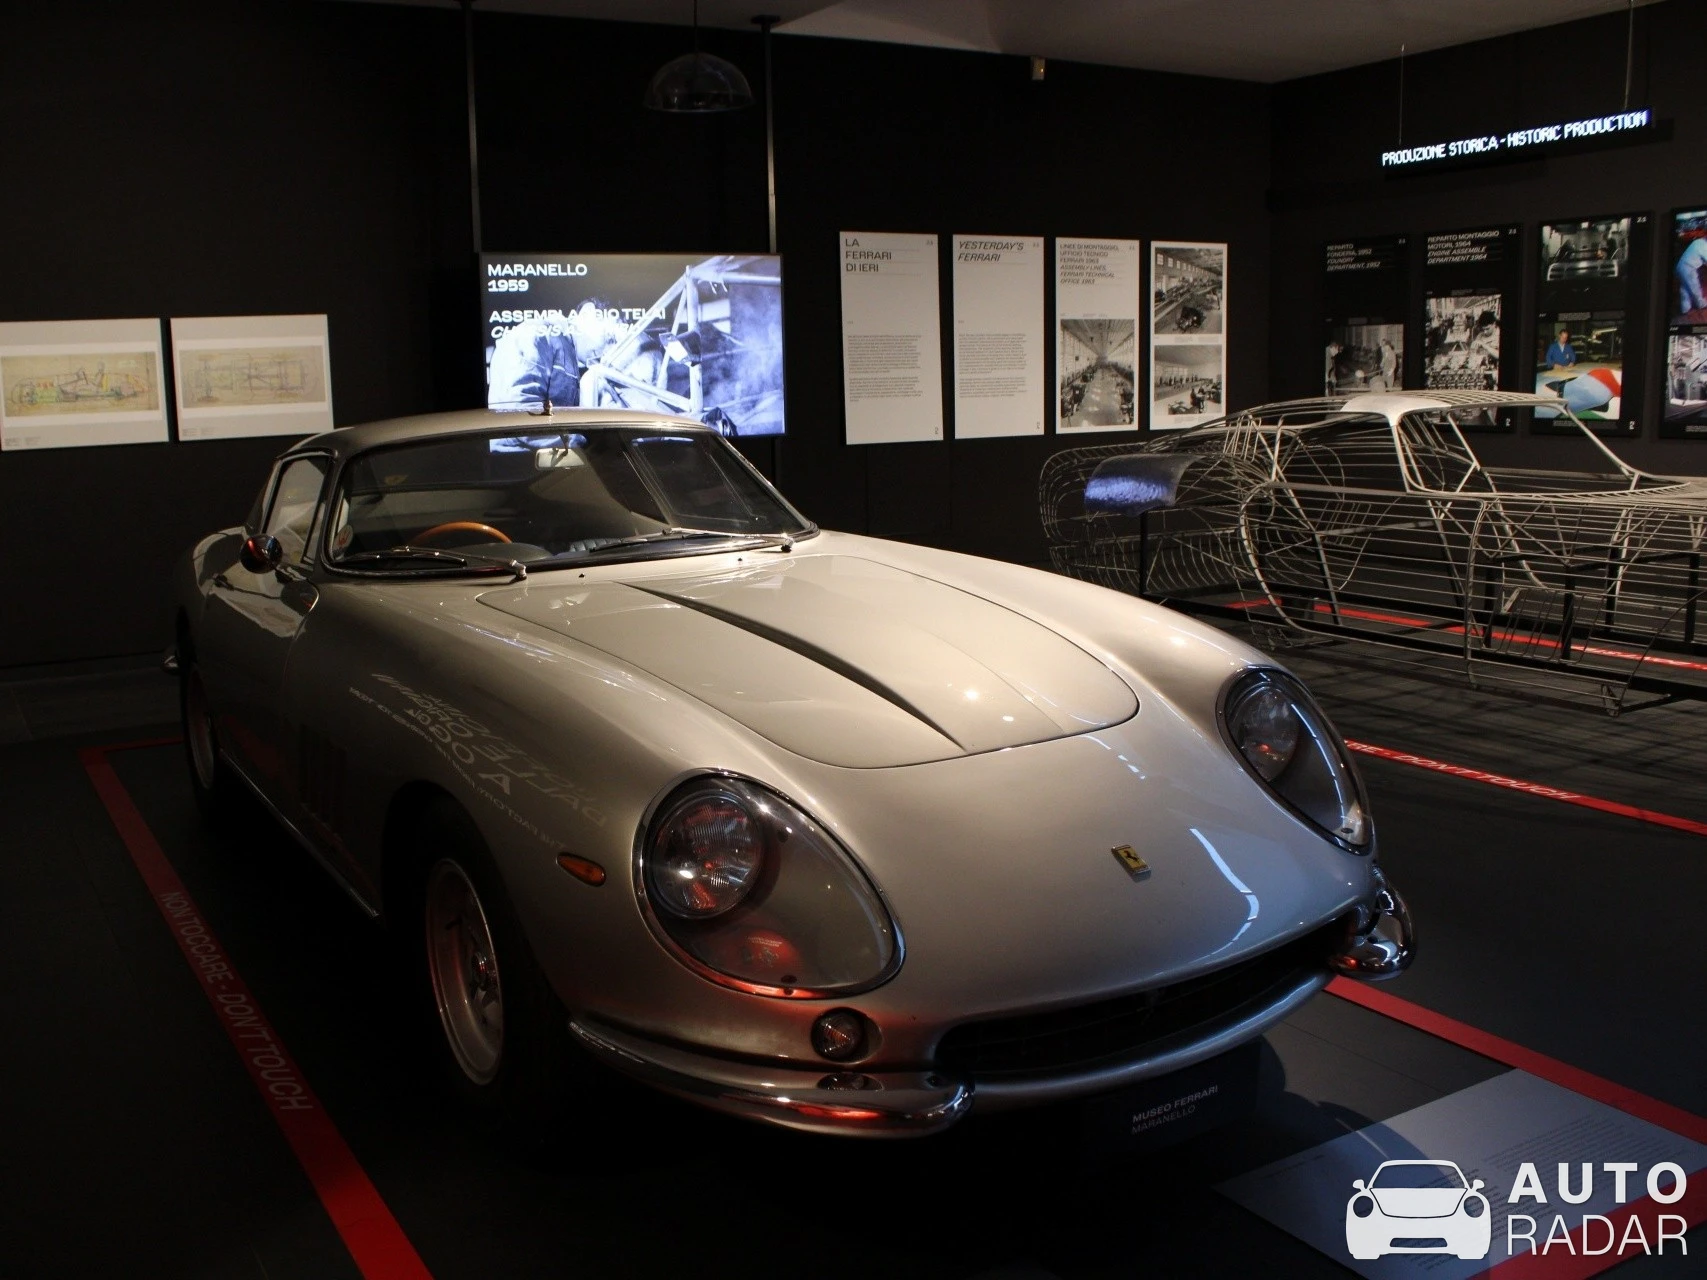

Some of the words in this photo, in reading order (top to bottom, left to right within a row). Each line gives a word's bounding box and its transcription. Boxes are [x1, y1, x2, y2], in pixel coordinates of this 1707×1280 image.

[1382, 143, 1447, 167] PRODUZIONE
[1448, 136, 1498, 157] STORICA
[1507, 125, 1561, 148] HISTORIC
[1564, 110, 1648, 139] PRODUCTION
[845, 238, 859, 247] LA
[958, 240, 1024, 250] YESTERDAY'S
[845, 250, 892, 260] FERRARI
[957, 252, 1001, 262] FERRARI
[488, 263, 587, 276] MARANELLO
[846, 263, 857, 272] DI
[859, 263, 879, 273] IERI
[488, 279, 529, 292] 1959
[1475, 773, 1583, 799] TOUCH
[161, 891, 192, 918] NON
[177, 916, 234, 984] TOCCARE
[217, 992, 273, 1042] DON'T
[247, 1043, 313, 1111] TOUCH
[1132, 1103, 1172, 1123] MUSEO
[1174, 1085, 1218, 1109] FERRARI
[1131, 1104, 1196, 1135] MARANELLO
